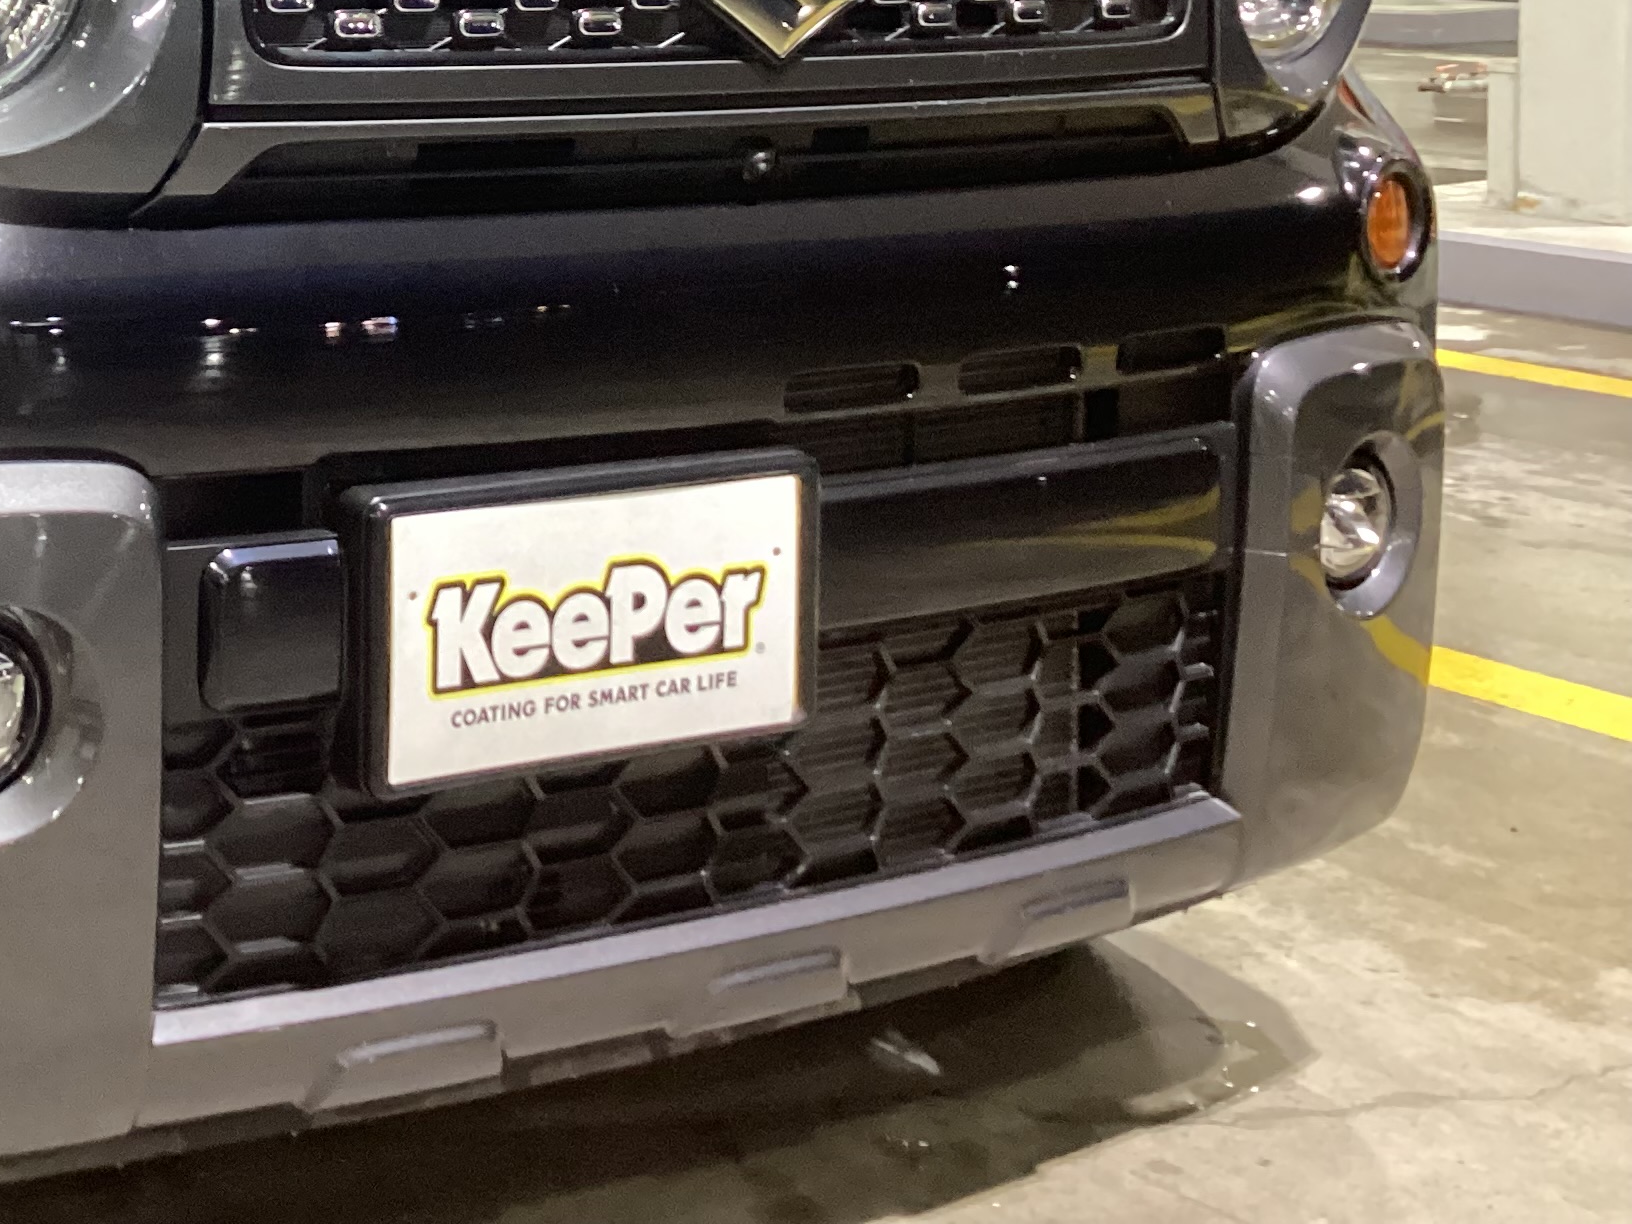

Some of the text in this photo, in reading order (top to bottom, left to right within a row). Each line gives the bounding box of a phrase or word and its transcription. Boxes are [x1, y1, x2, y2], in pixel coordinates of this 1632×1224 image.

[428, 556, 766, 696] KeePer
[451, 670, 738, 729] COATING FOR SMART CAR LIFE
